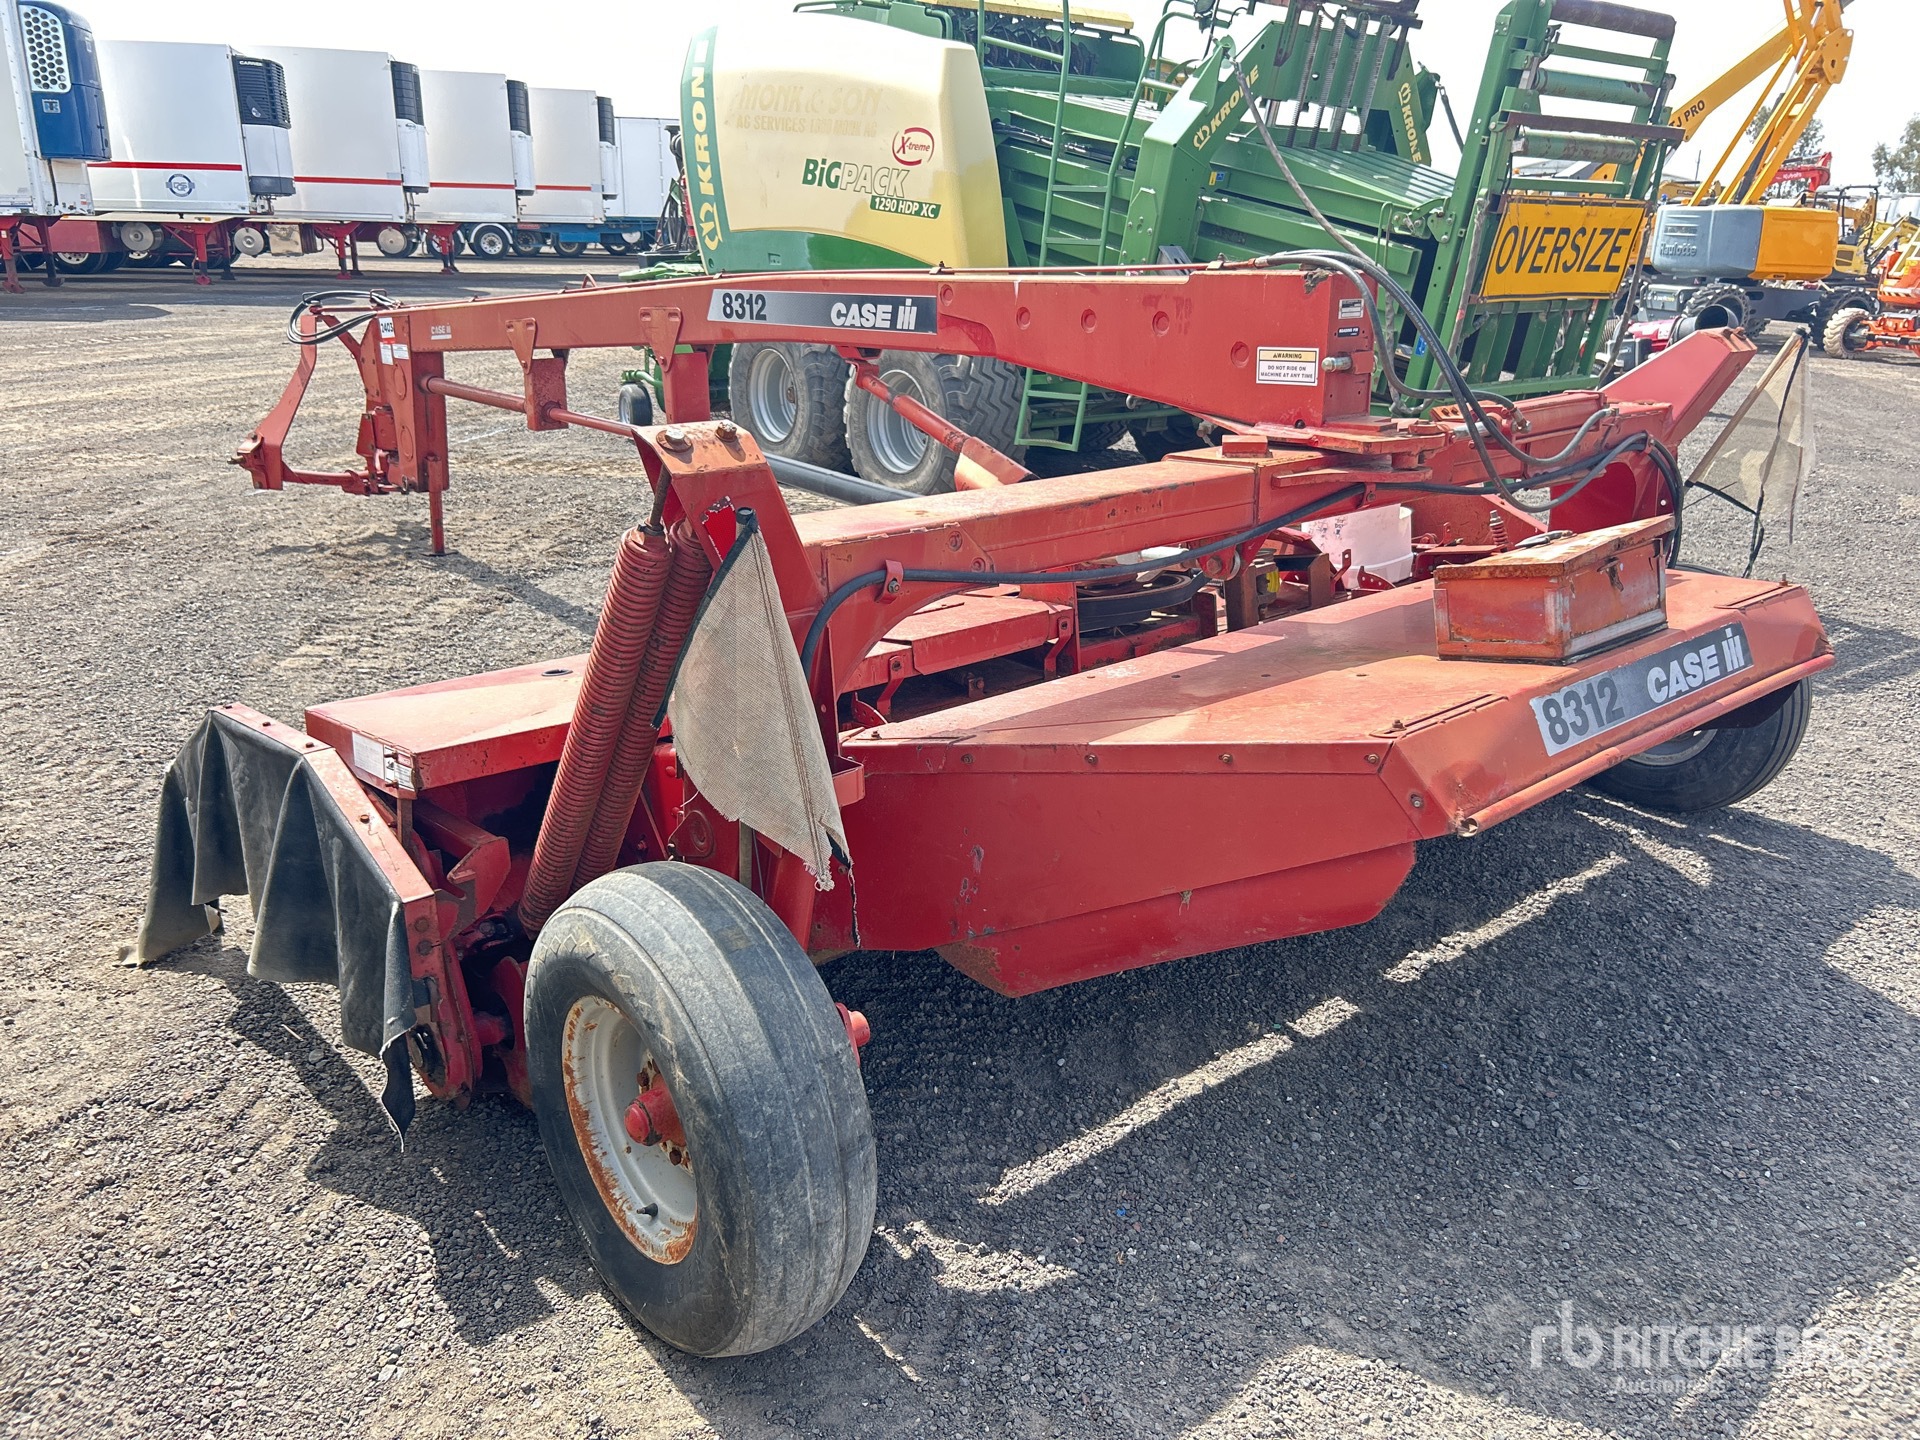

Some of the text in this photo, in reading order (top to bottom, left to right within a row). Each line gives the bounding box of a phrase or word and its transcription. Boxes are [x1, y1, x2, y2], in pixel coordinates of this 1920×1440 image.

[738, 84, 803, 112] MONK
[828, 88, 883, 115] SON
[1684, 100, 1705, 122] PRO
[736, 114, 751, 129] AG
[754, 115, 807, 133] SERVICES
[1402, 105, 1422, 162] KRONE
[896, 136, 931, 154] X-treme
[875, 197, 936, 217] 1290 HDP XC
[1495, 225, 1632, 275] OVERSIZE
[1660, 242, 1698, 257] Haulotte
[722, 293, 767, 321] 8312
[831, 302, 893, 329] CASE
[431, 326, 445, 334] CASE
[1542, 677, 1626, 745] 8312
[1646, 644, 1721, 704] CASE
